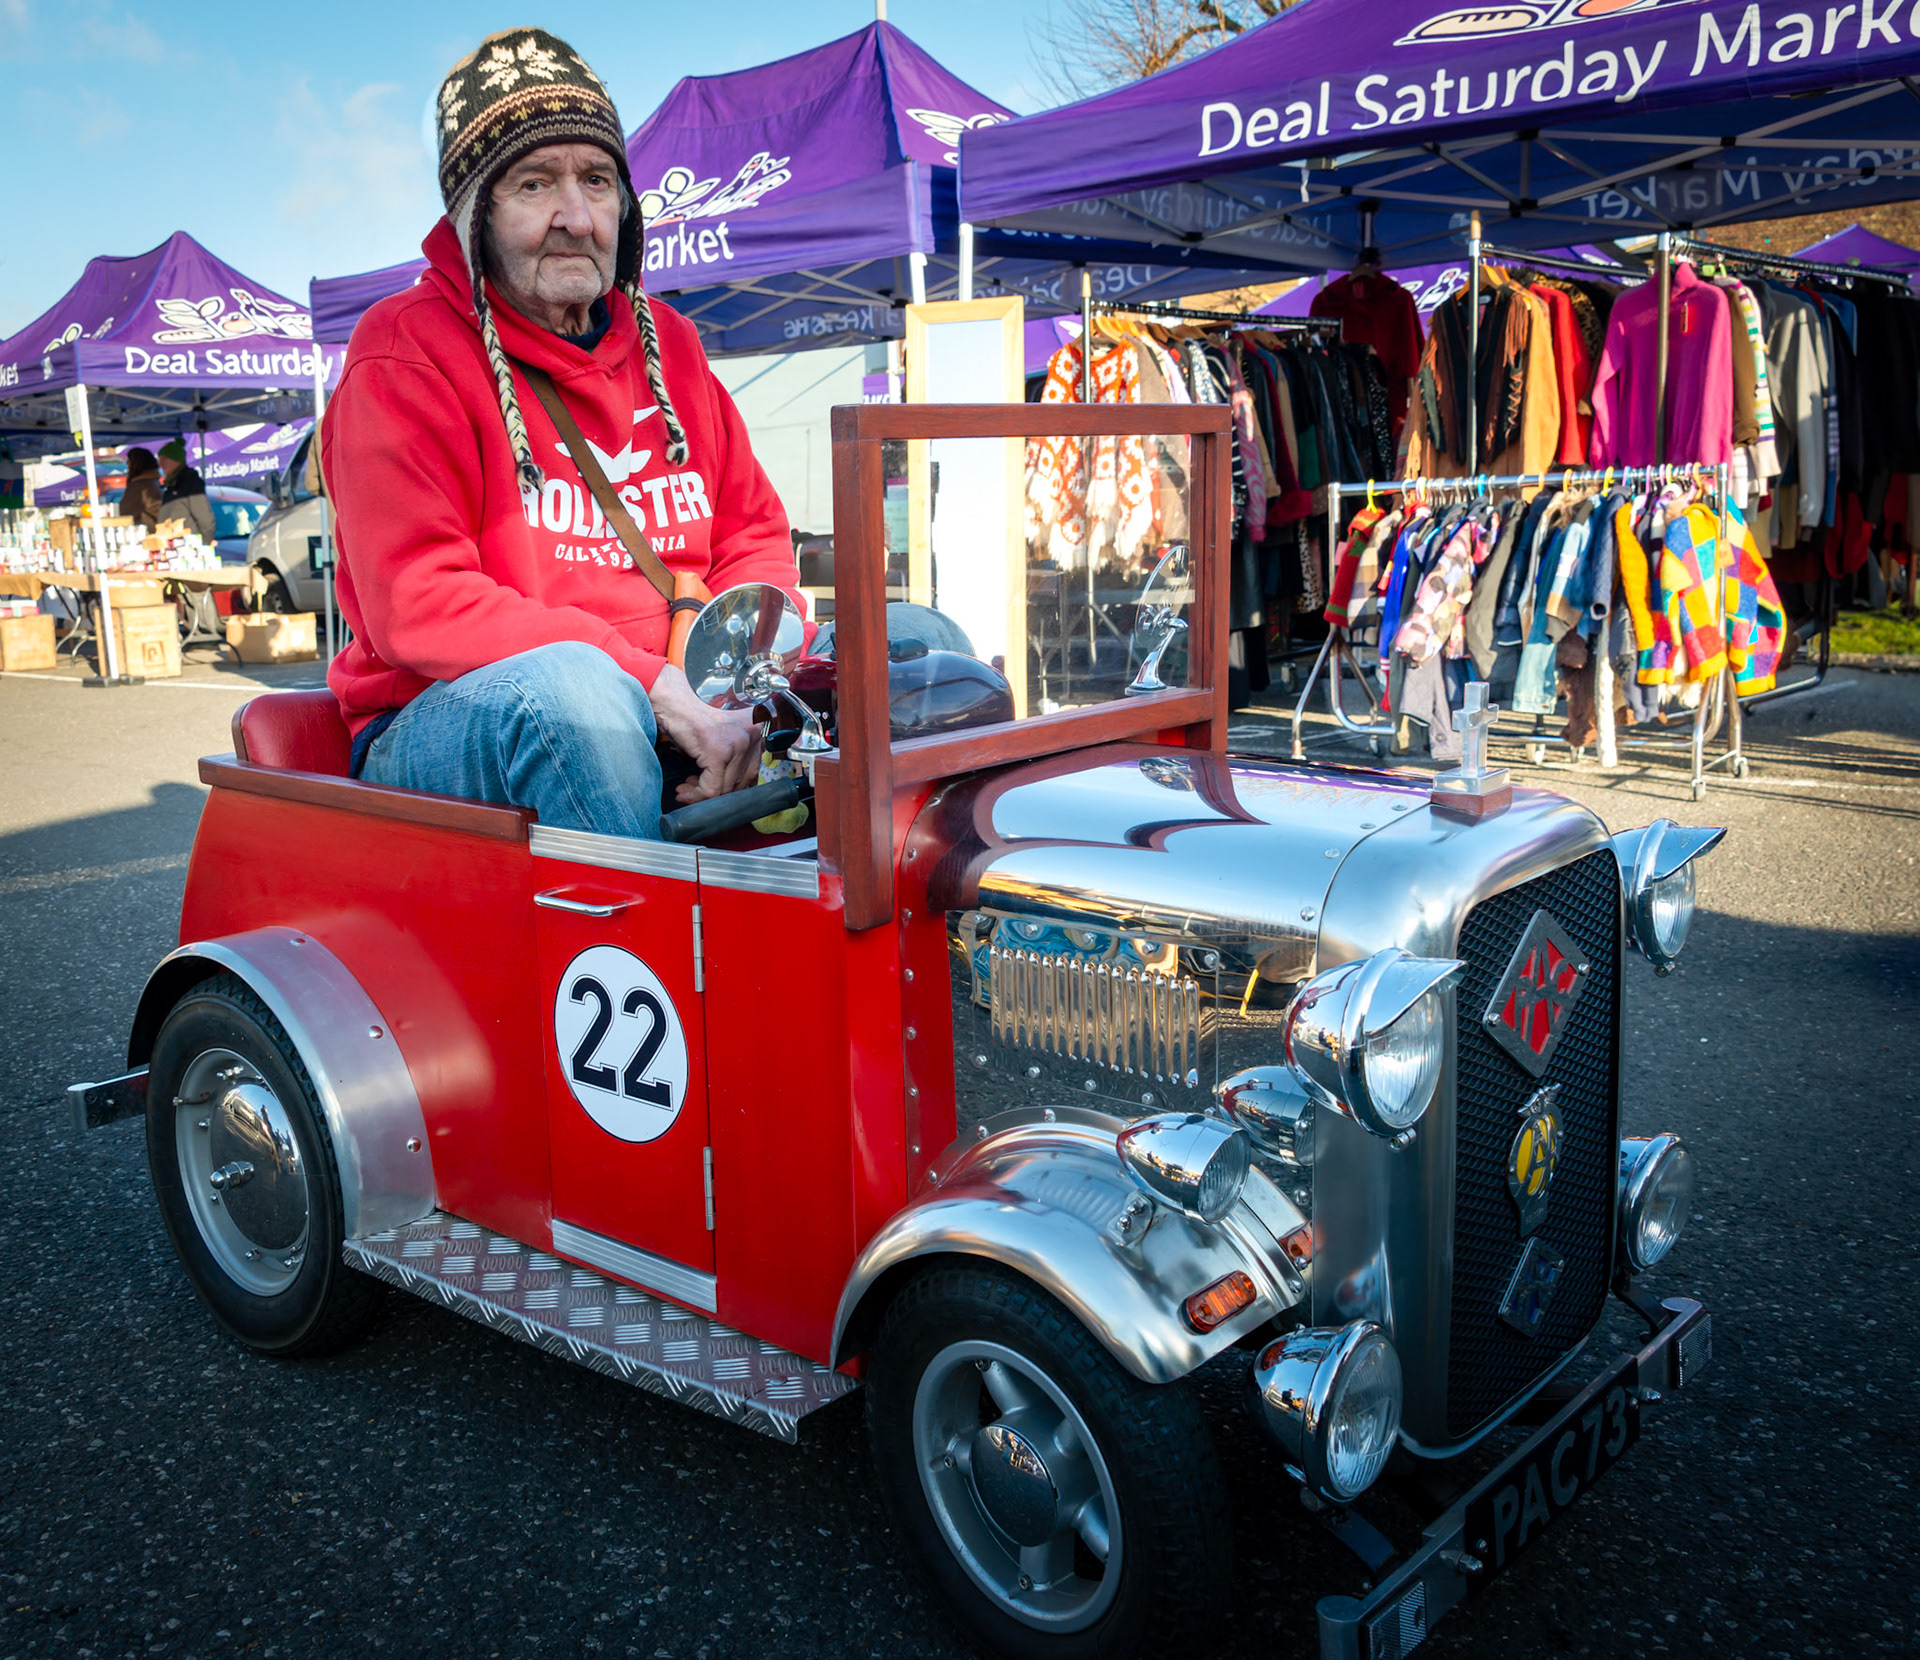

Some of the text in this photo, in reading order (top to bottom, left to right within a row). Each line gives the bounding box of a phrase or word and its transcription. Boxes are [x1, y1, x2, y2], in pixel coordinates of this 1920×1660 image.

[1198, 81, 1330, 157] Deal
[1351, 39, 1667, 130] Saturday
[640, 221, 734, 272] arket
[124, 346, 198, 375] Deal
[205, 346, 333, 383] Saturday
[213, 460, 250, 478] Saturday
[250, 455, 280, 473] Market
[569, 974, 674, 1112] 22
